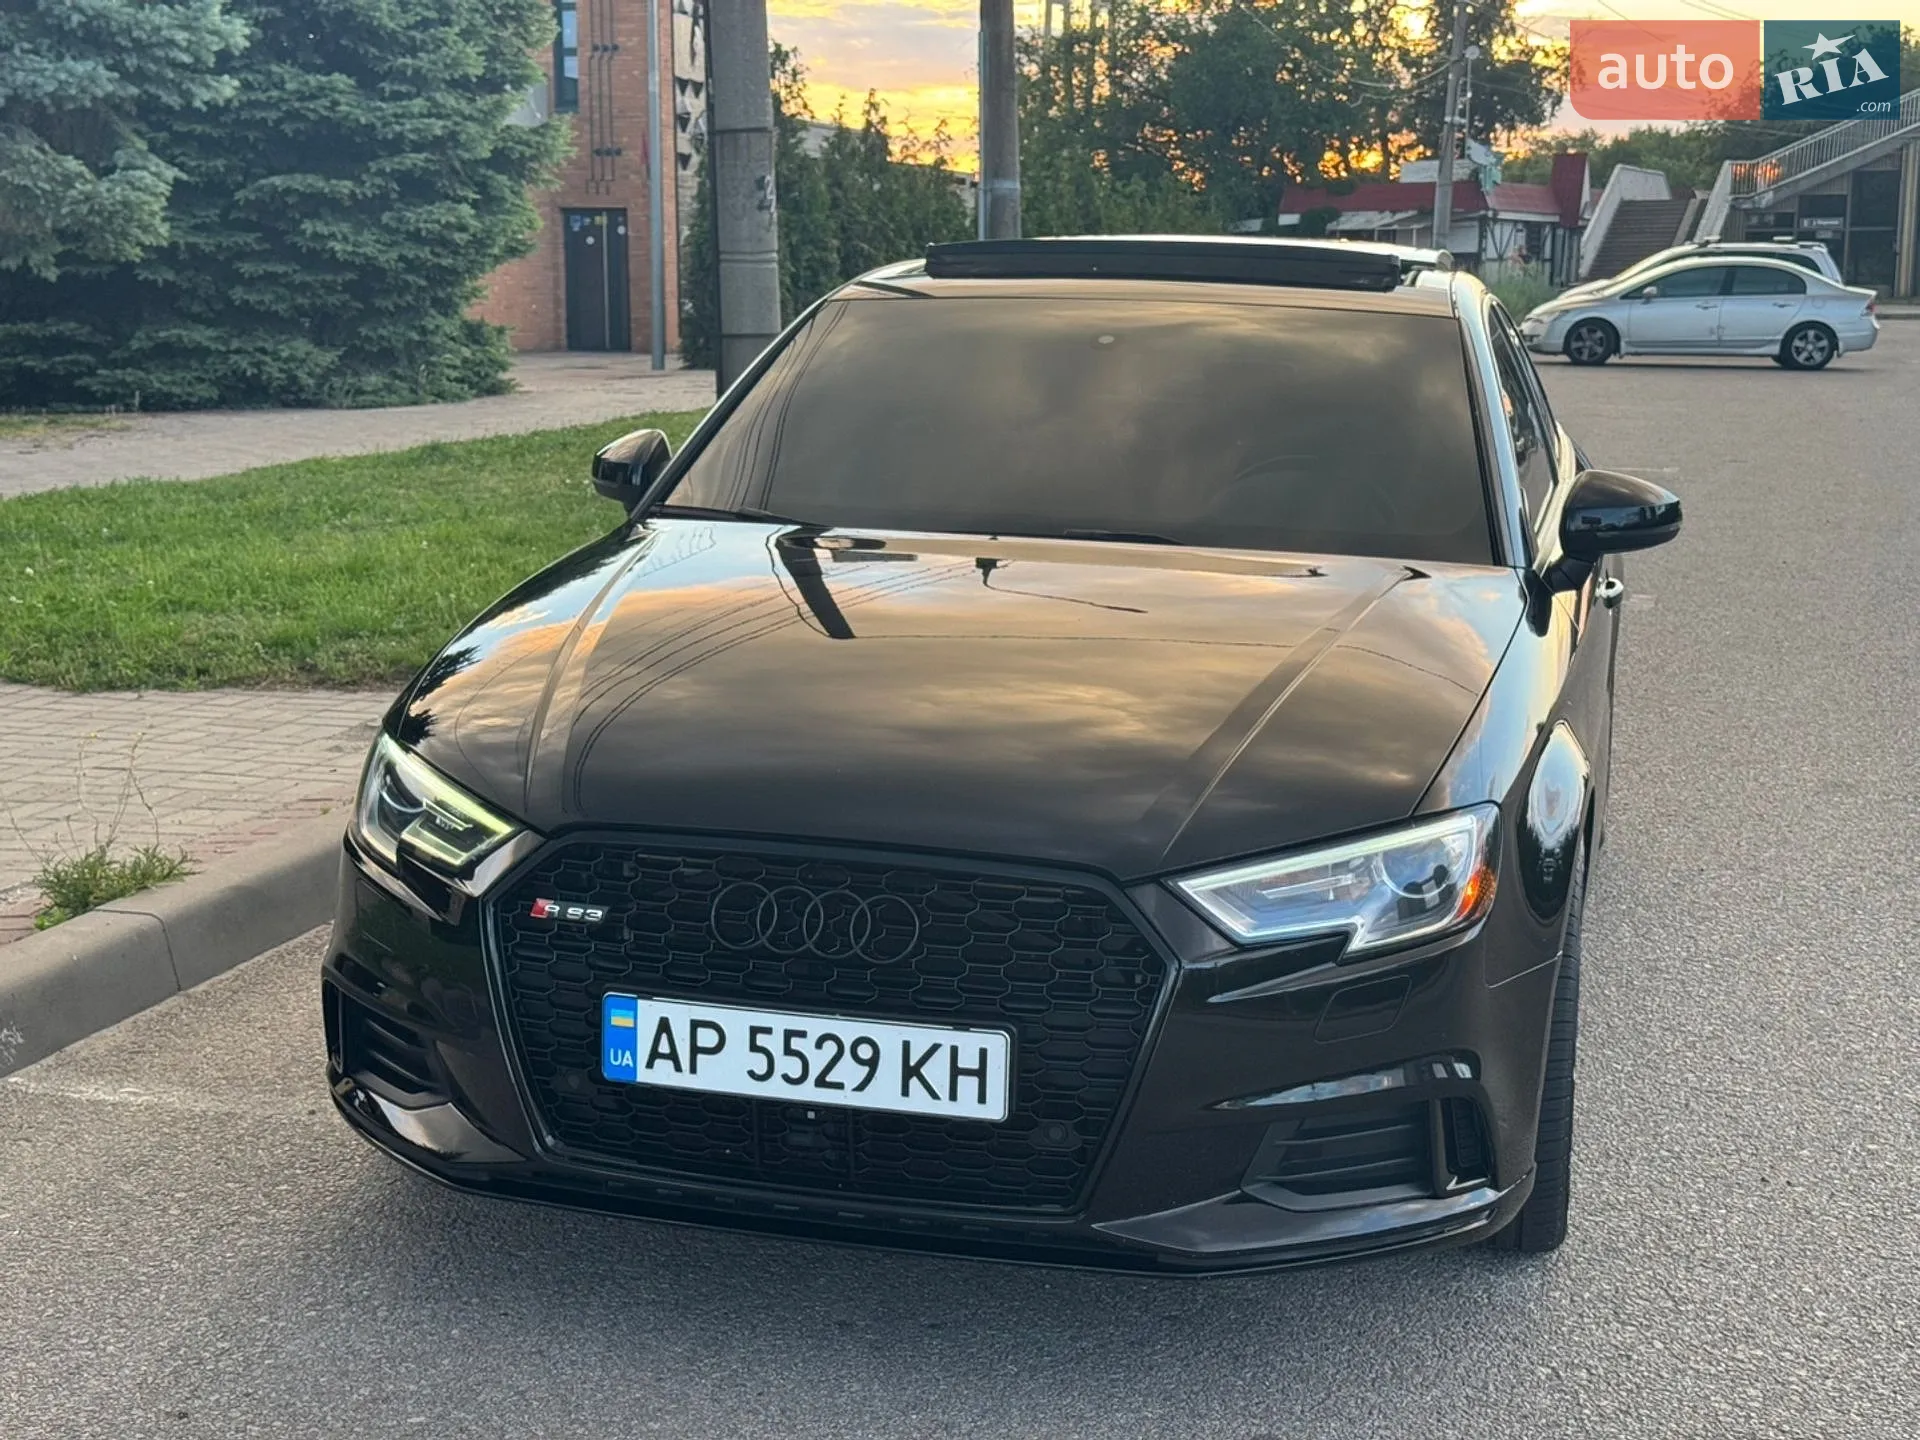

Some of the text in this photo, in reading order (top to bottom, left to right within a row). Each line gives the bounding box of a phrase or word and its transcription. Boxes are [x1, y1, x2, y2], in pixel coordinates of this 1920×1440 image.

[609, 1053, 634, 1069] UA
[645, 1016, 989, 1105] AP 5529 KH
